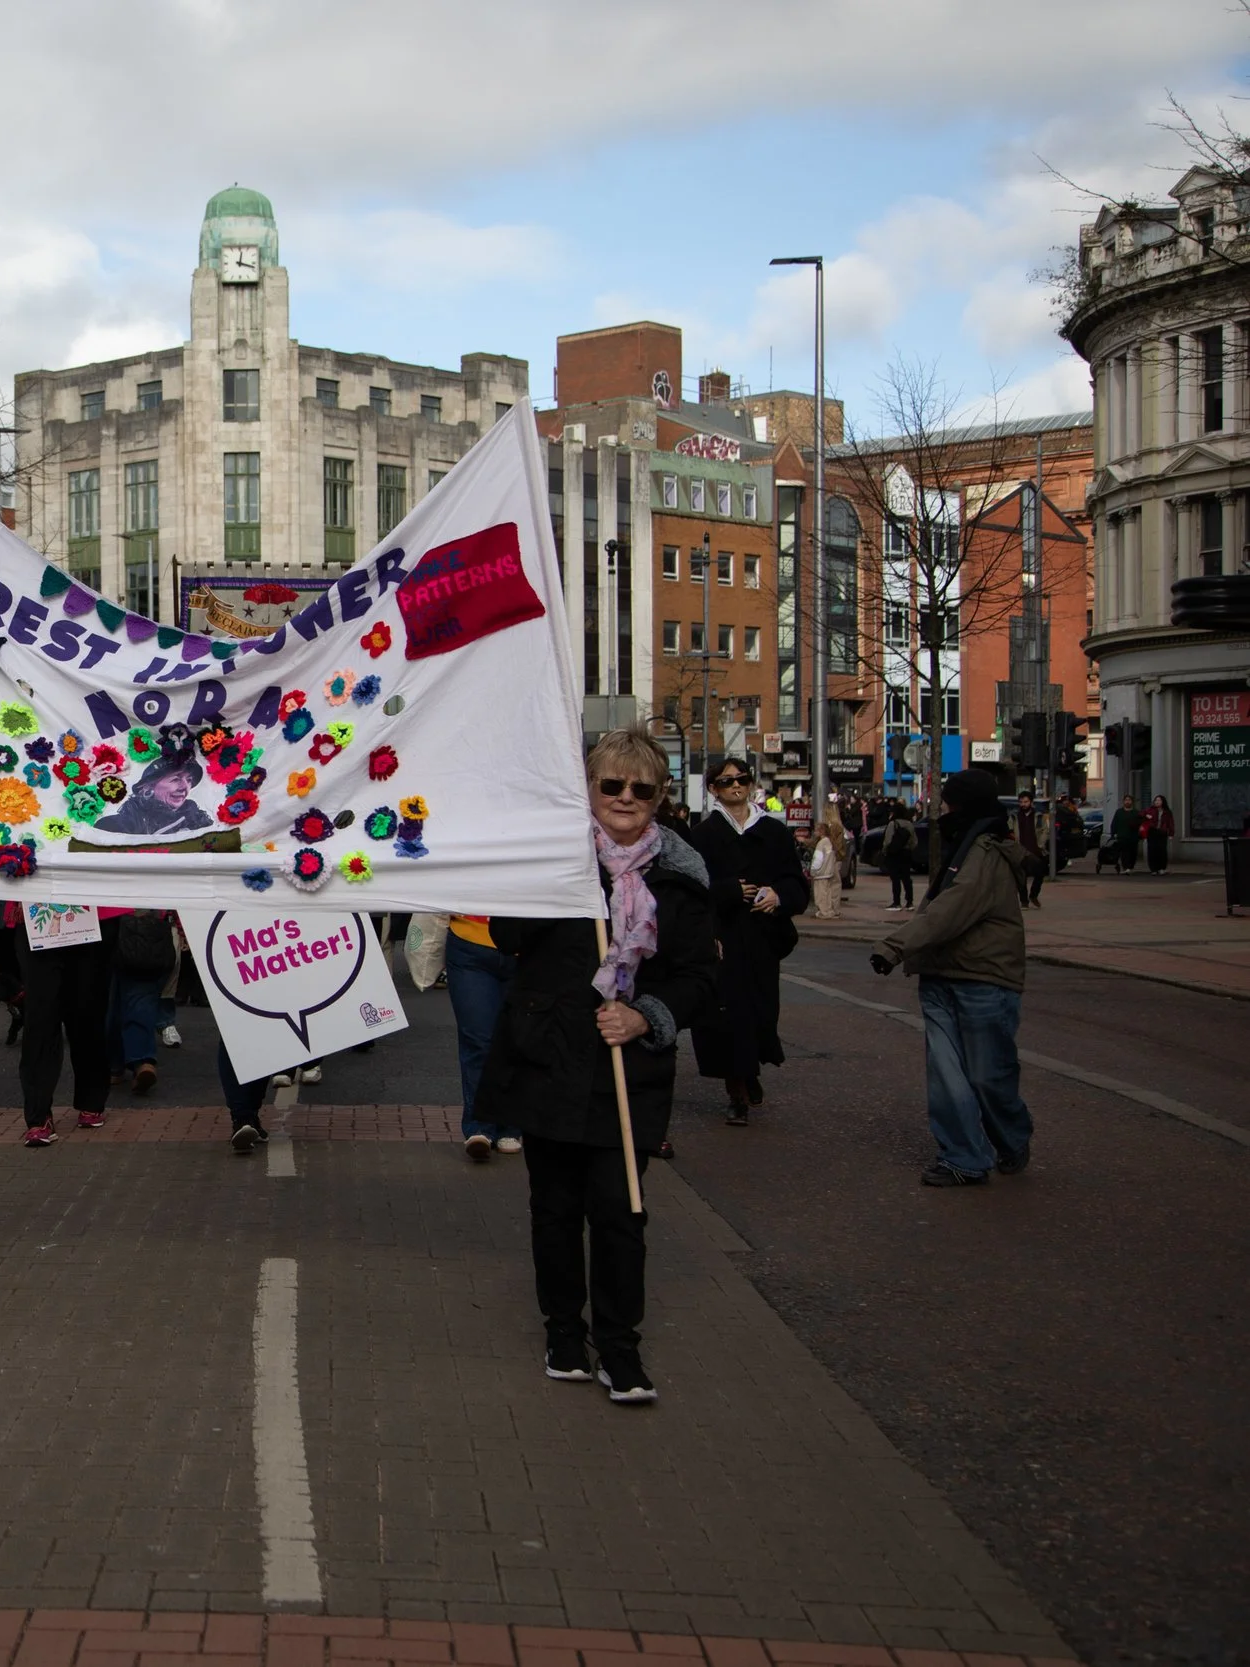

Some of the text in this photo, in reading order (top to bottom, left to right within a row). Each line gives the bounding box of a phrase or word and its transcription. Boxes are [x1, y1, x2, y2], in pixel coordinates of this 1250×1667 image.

[399, 554, 519, 612] PATTERNS
[210, 610, 257, 637] RECLAIM
[222, 547, 409, 675] OWER
[411, 616, 463, 647] WAR
[84, 678, 283, 740] NORA
[1193, 695, 1240, 712] TO LET
[1193, 713, 1240, 725] 90 324 555
[1193, 732, 1221, 743] PRIME
[1193, 743, 1247, 756] RETAIL UNIT
[227, 919, 301, 958] Ma's
[237, 926, 353, 985] Matter!
